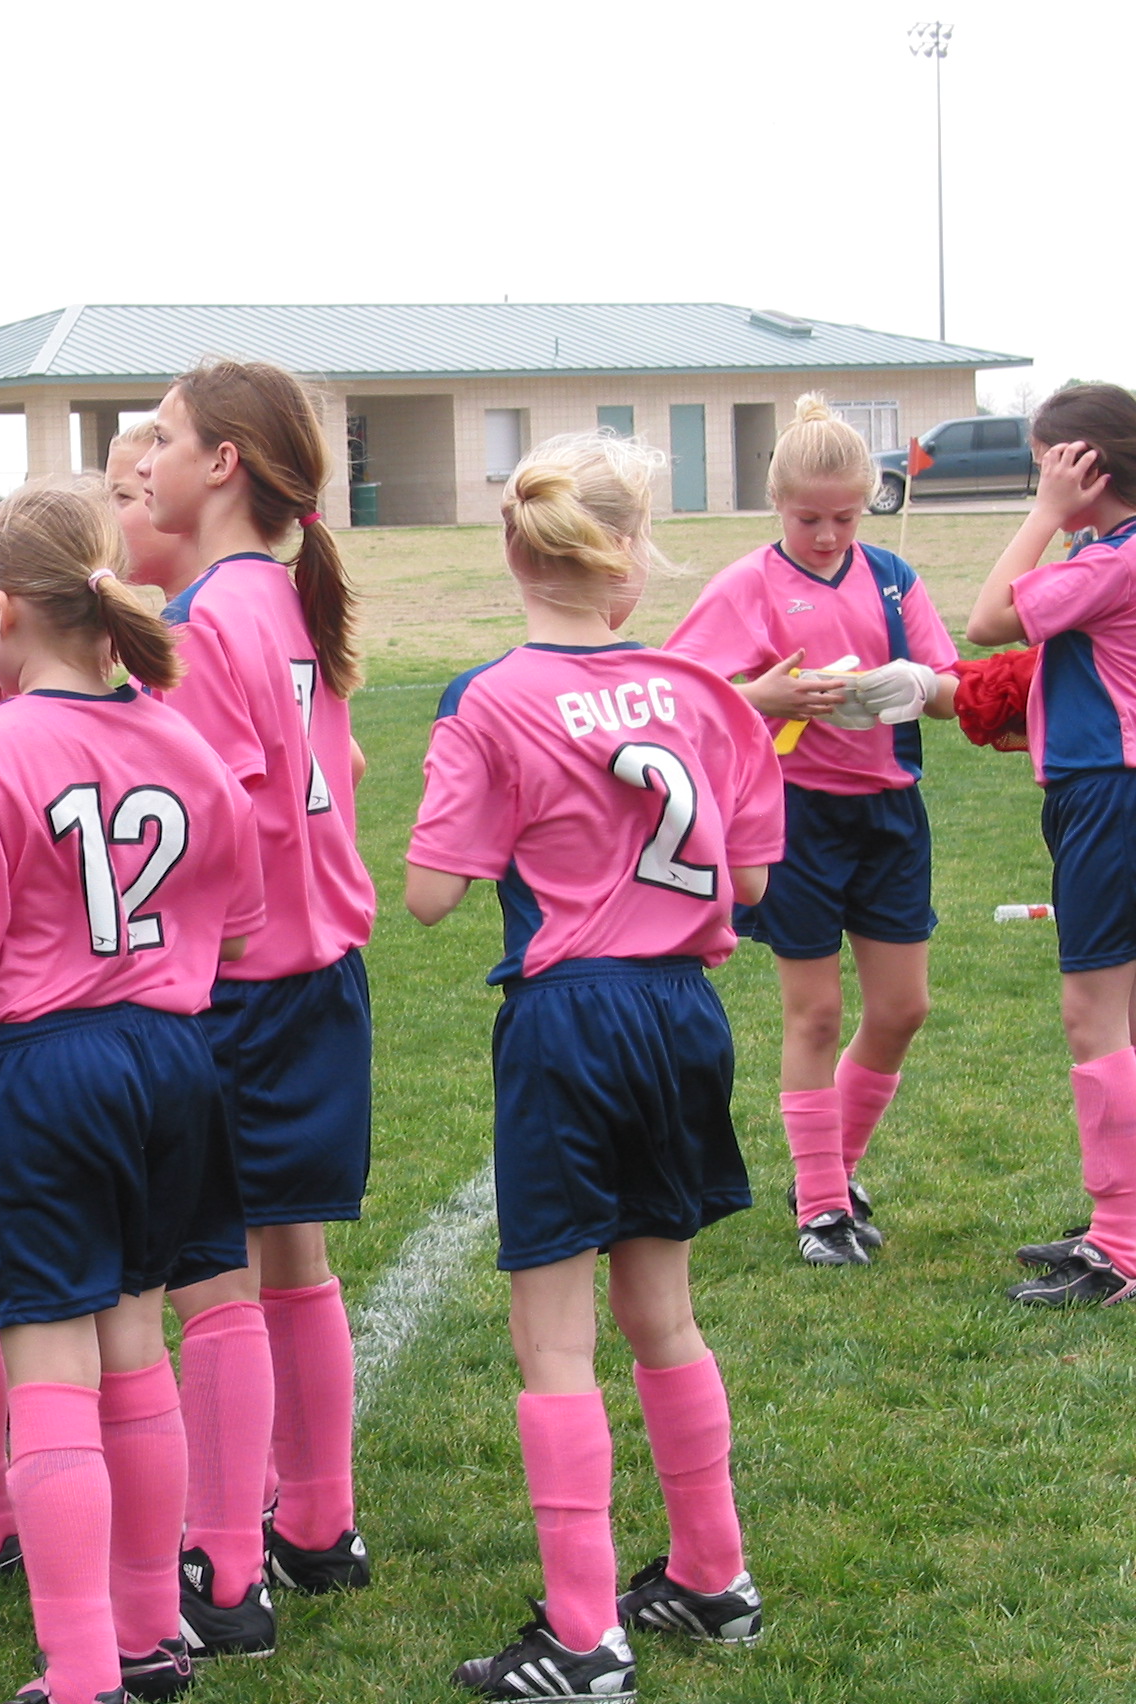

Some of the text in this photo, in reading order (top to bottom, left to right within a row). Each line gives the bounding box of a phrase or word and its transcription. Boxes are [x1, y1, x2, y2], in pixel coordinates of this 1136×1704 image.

[556, 677, 675, 738] BUGG
[44, 782, 190, 957] 12
[607, 741, 718, 902] 2
